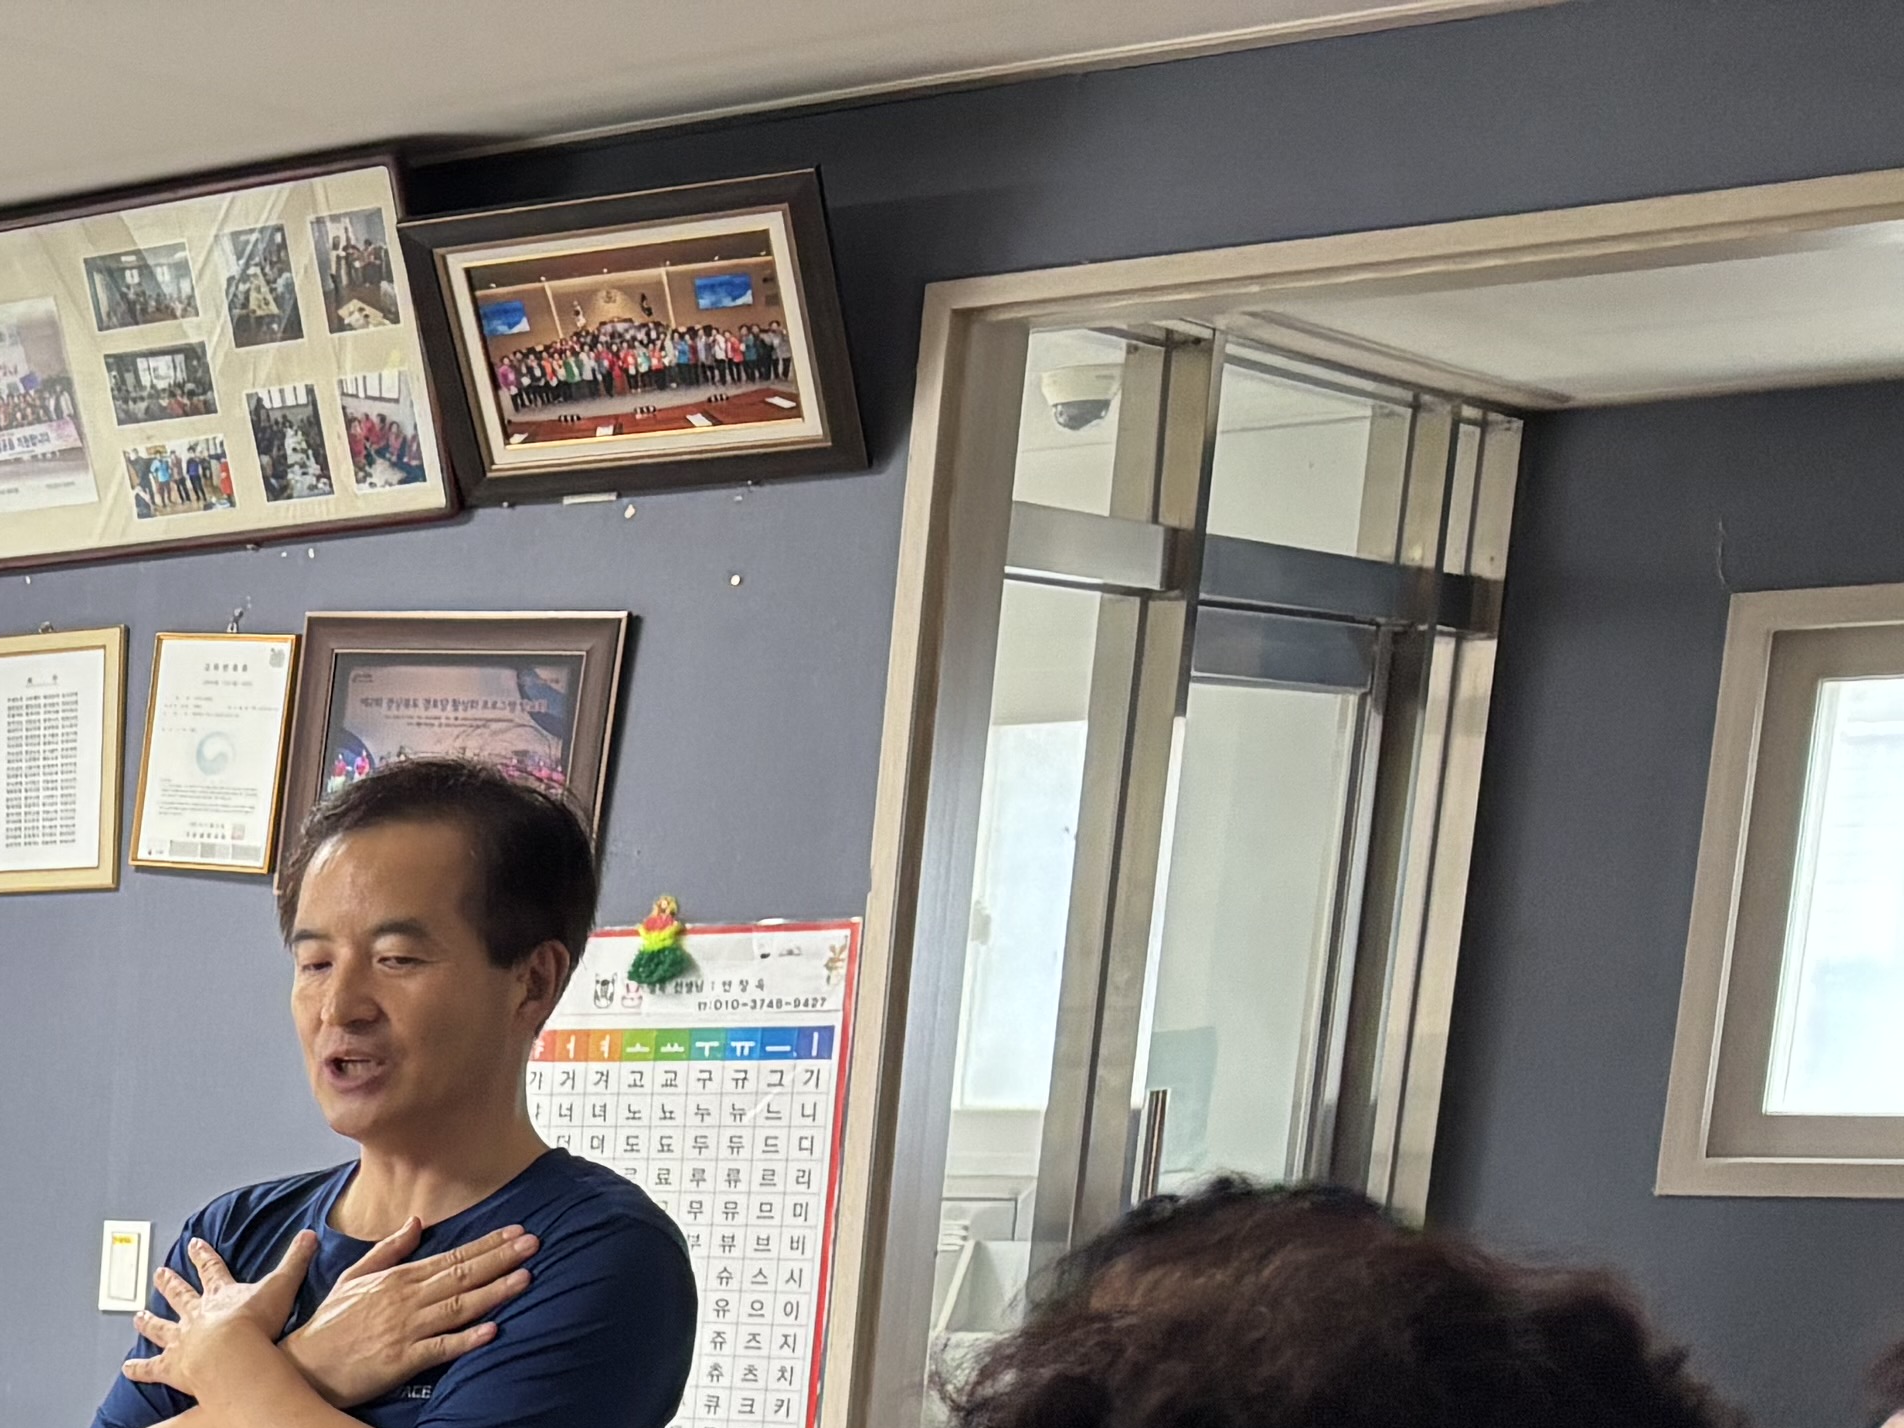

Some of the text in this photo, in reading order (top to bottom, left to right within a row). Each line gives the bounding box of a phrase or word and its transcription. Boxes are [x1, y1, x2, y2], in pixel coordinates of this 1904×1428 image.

[560, 1069, 575, 1091] 거
[593, 1069, 609, 1090] 겨
[628, 1071, 644, 1088] 고
[661, 1070, 678, 1088] 교
[697, 1070, 713, 1090] 구
[731, 1069, 749, 1089] 규
[767, 1070, 784, 1087] 그
[803, 1068, 820, 1089] 기
[559, 1102, 817, 1123] 너 녀 노 뇨 누 뉴 느 니
[624, 1135, 640, 1152] 도
[657, 1136, 674, 1153] 됴
[692, 1135, 709, 1155] 두
[727, 1135, 744, 1155] 듀
[762, 1136, 779, 1153] 드
[799, 1135, 814, 1156] 디
[655, 1168, 811, 1189] 료 루 류 르 리
[687, 1200, 808, 1222] 무 뮤 므 미
[719, 1234, 736, 1253] 뷰
[754, 1235, 771, 1252] 브
[790, 1235, 805, 1255] 비
[717, 1267, 803, 1288] 슈 스 시
[713, 1298, 799, 1321] 유 으 이
[710, 1331, 796, 1353] 쥬 즈 지
[707, 1363, 793, 1386] 츄 츠 치
[704, 1395, 790, 1418] 큐 크 키
